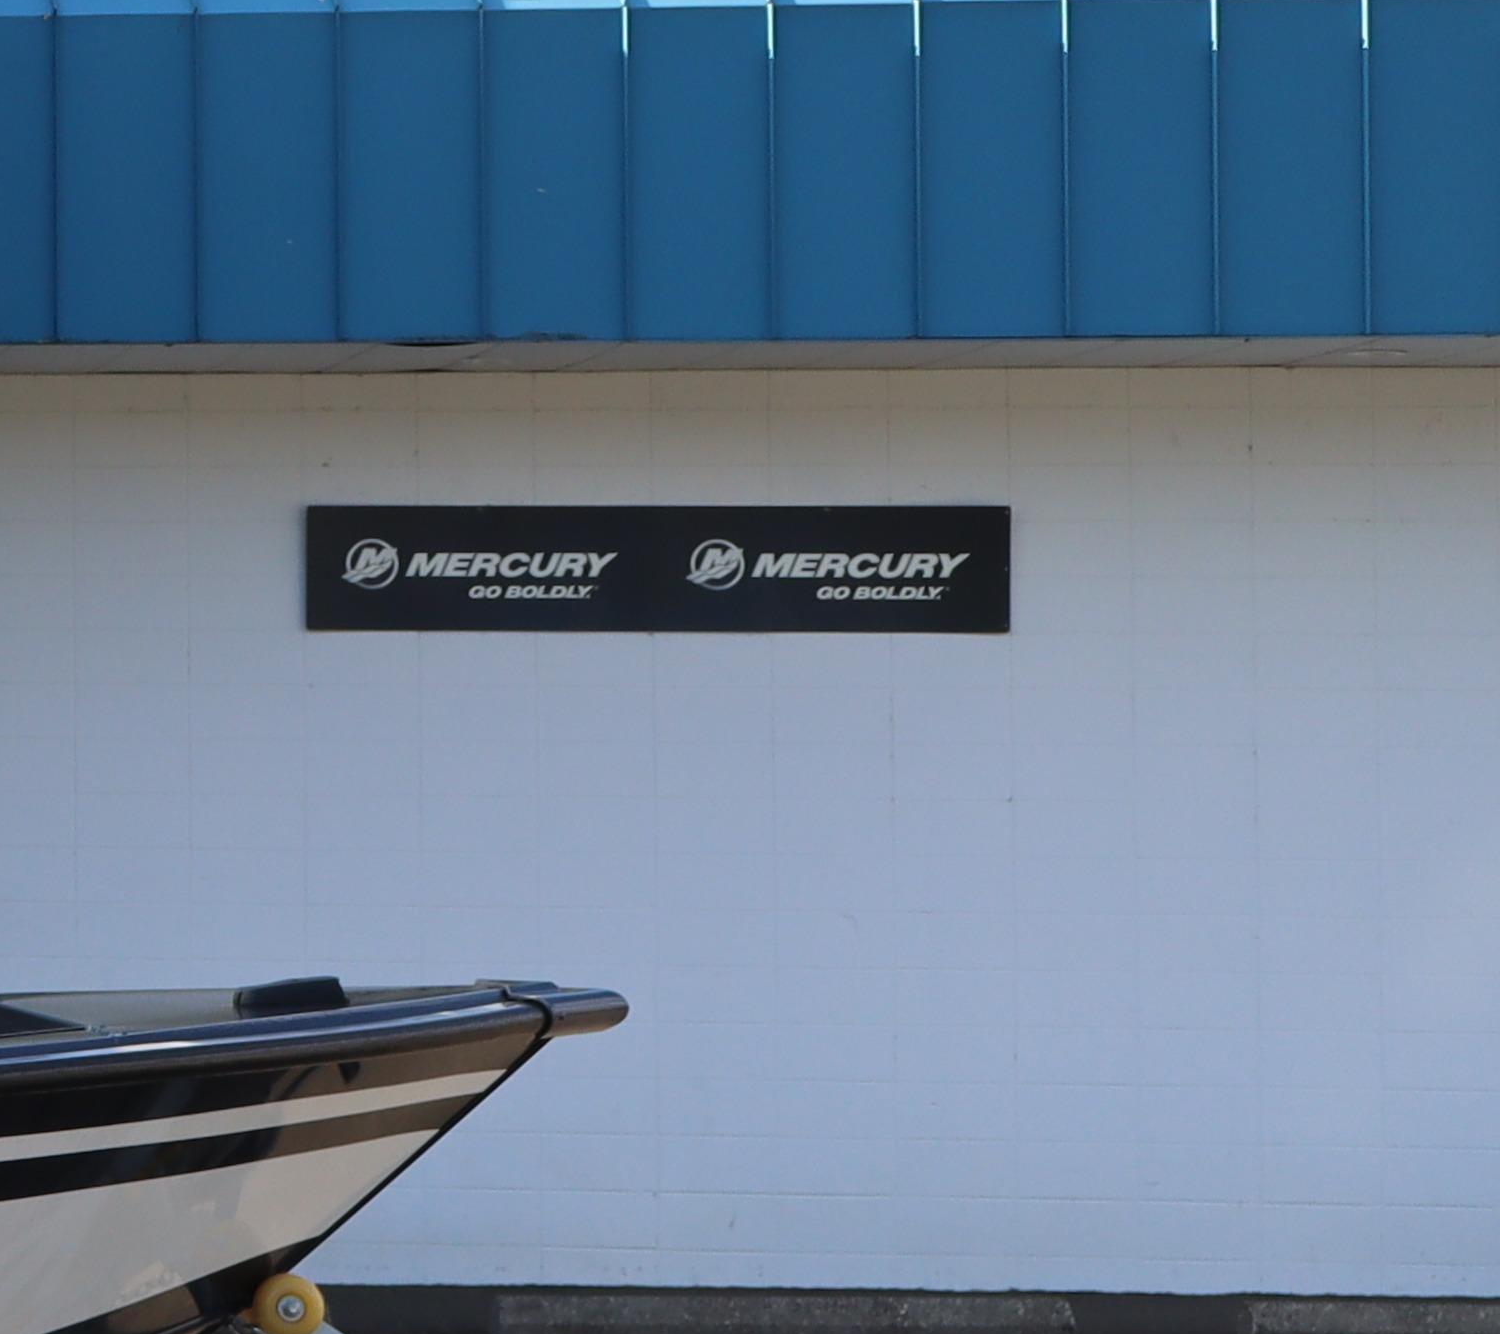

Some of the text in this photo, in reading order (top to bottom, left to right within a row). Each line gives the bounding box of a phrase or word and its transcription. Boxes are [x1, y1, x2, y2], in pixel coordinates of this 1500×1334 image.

[405, 552, 618, 578] MERCURY
[751, 553, 970, 579] MERCURY
[468, 585, 502, 599] GO
[816, 586, 850, 600] GO
